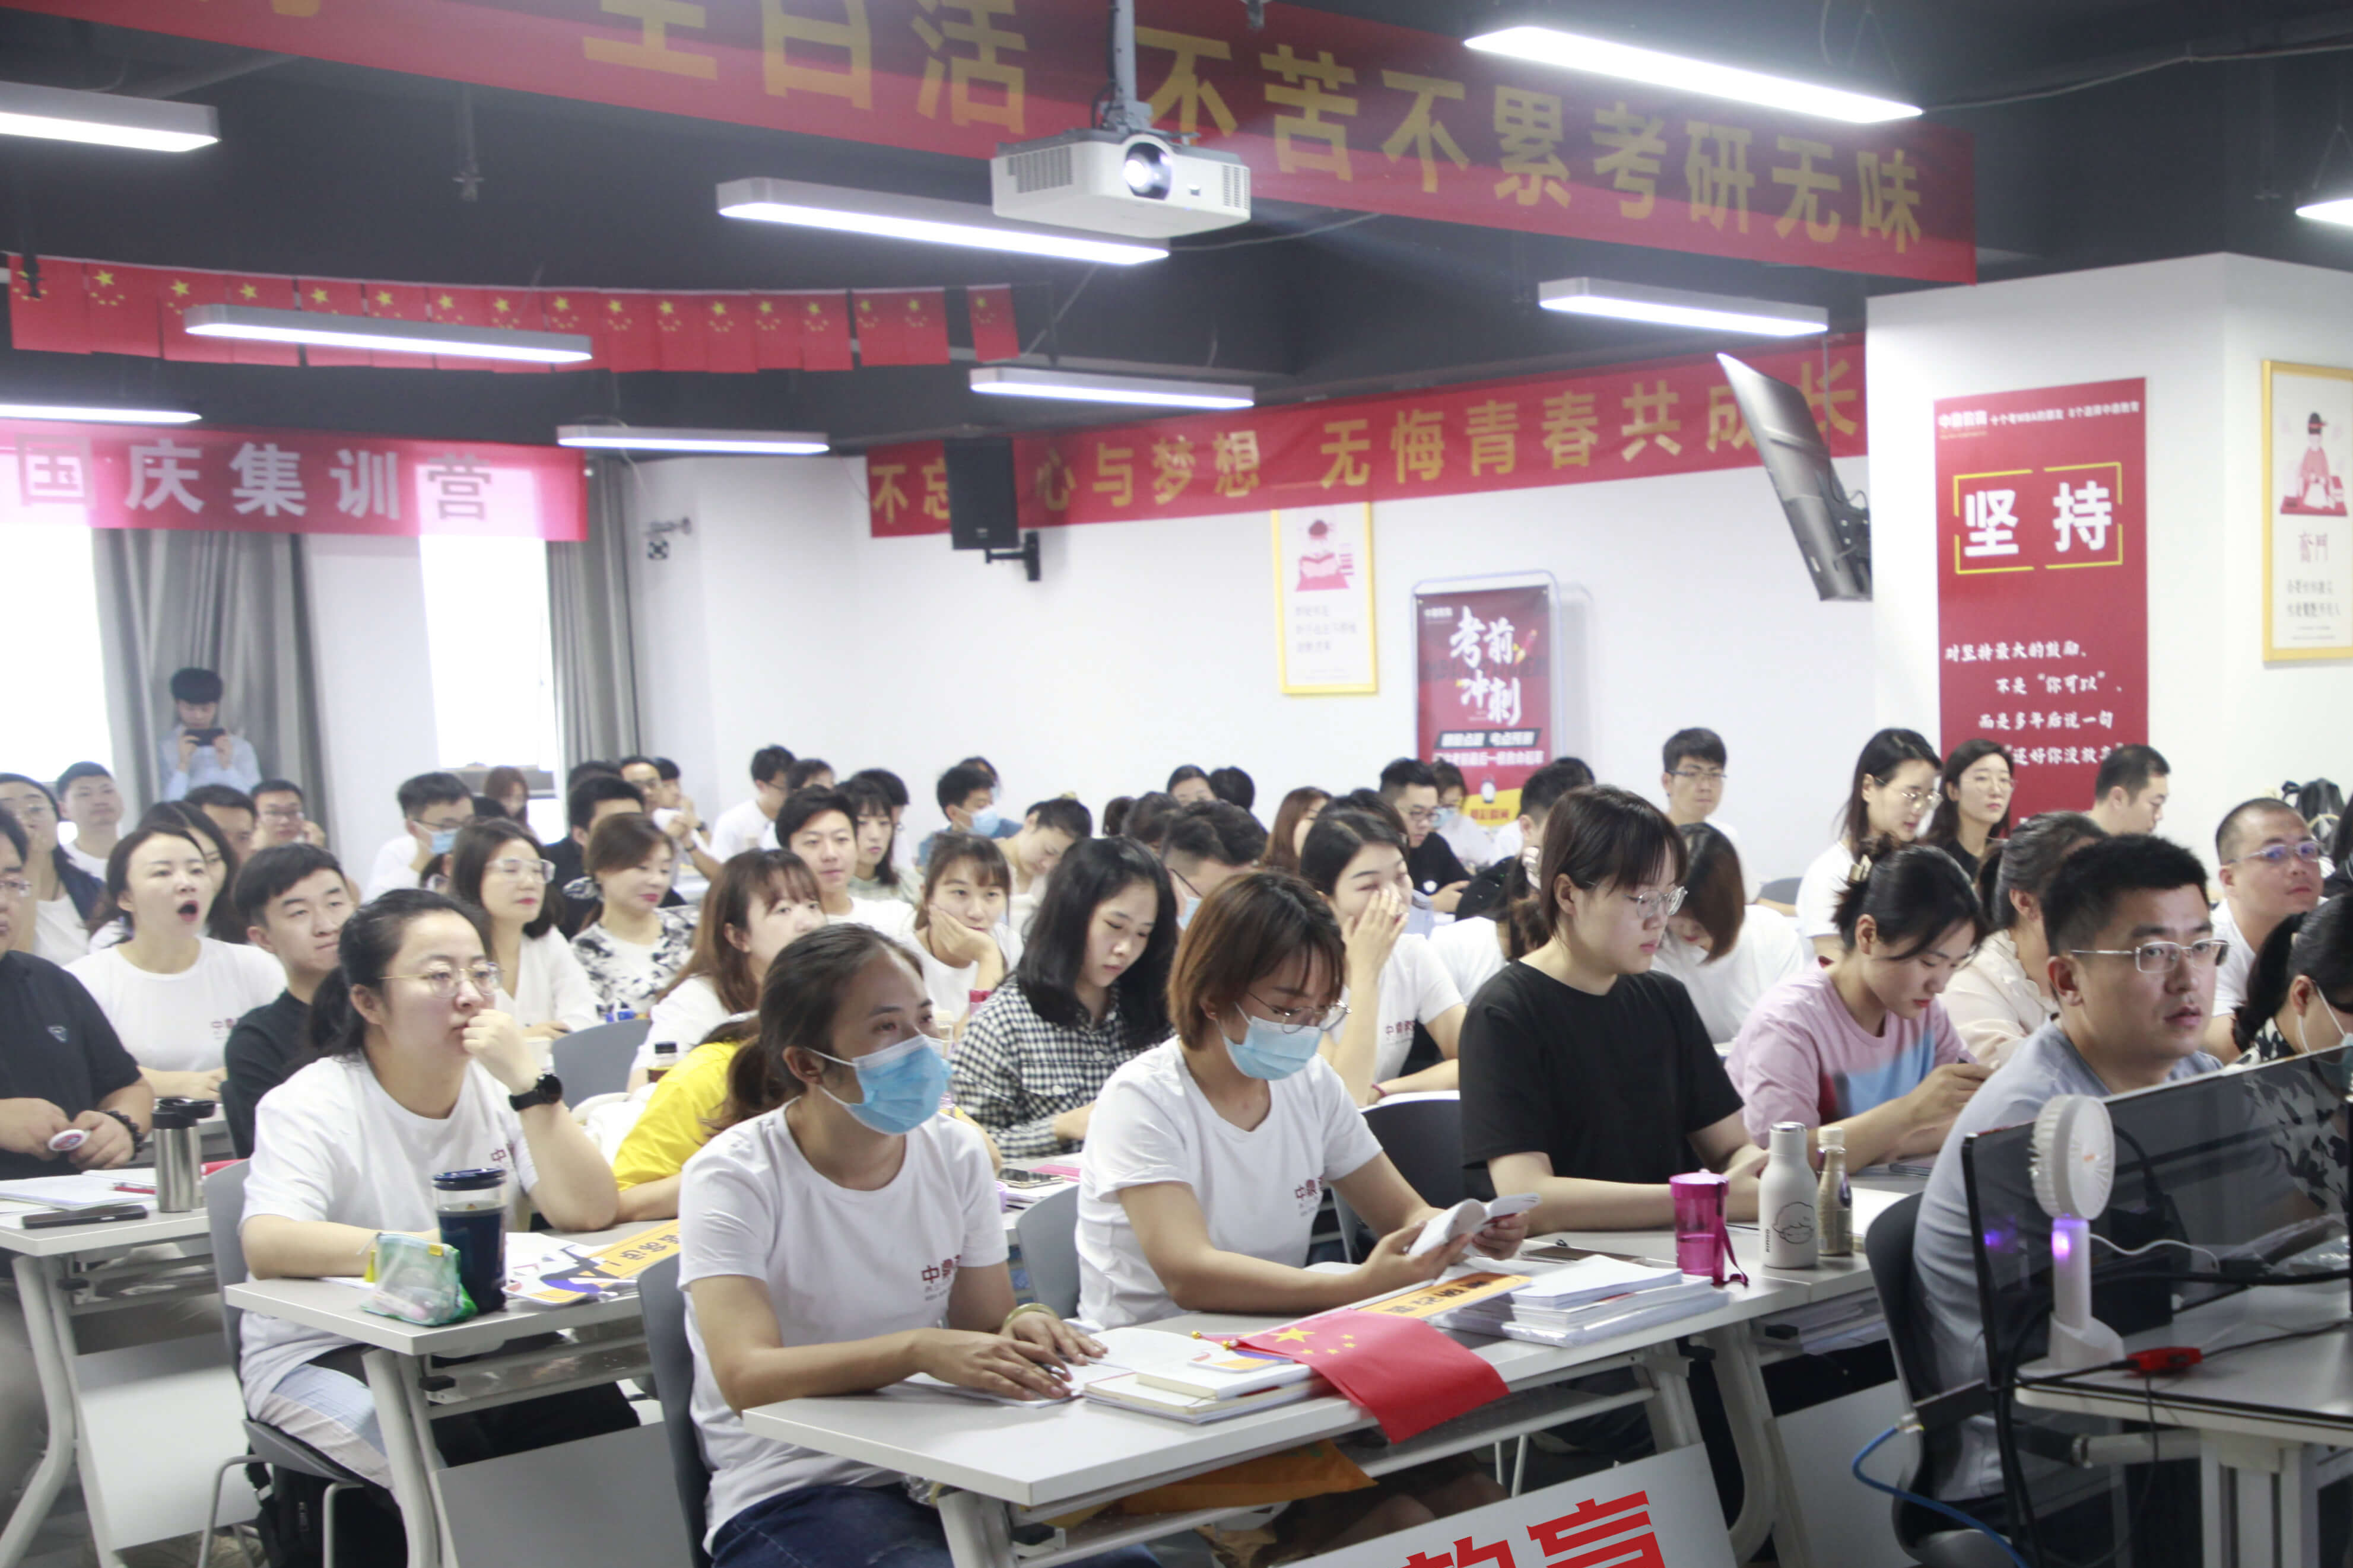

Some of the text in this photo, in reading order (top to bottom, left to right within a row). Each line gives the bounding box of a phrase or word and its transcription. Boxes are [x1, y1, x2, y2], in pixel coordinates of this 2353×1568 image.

[1136, 26, 1920, 254] 不苦不累考研无味
[15, 433, 491, 520] 国庆集训营
[871, 430, 1260, 523] 不忘心与梦想
[1964, 481, 2112, 557] 坚持
[1449, 605, 1515, 669] 考前
[1457, 669, 1522, 726] 冲刺
